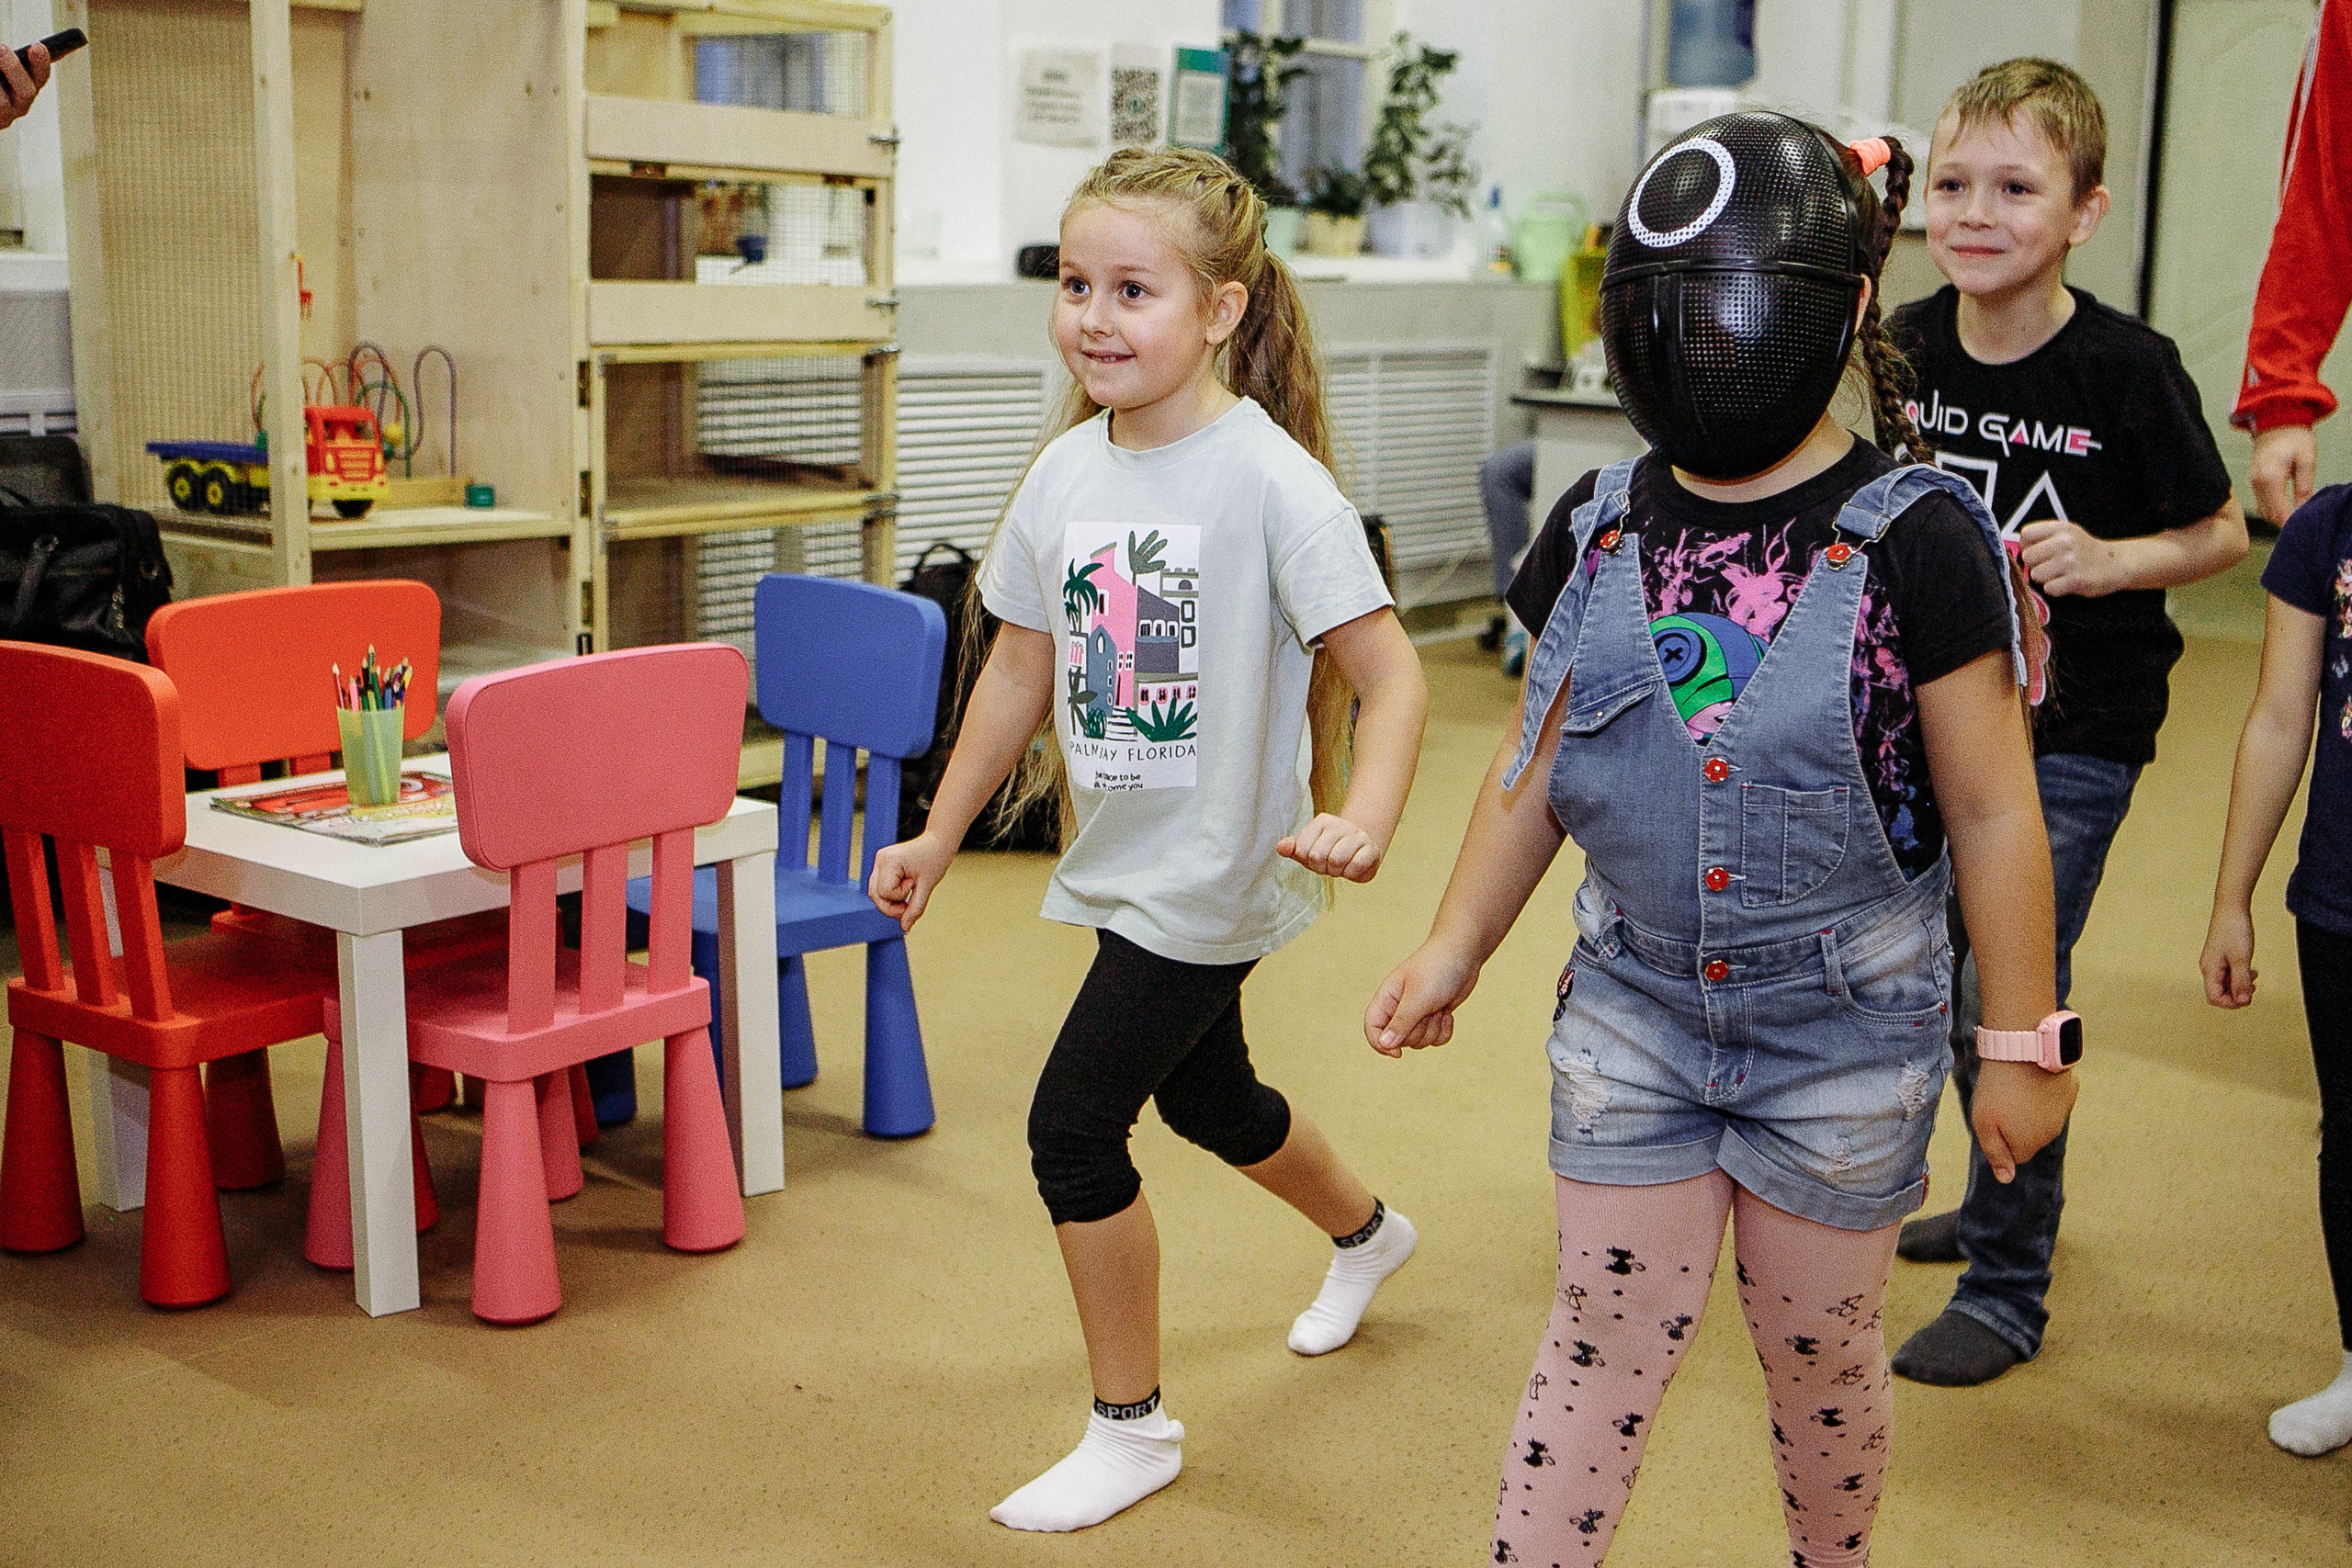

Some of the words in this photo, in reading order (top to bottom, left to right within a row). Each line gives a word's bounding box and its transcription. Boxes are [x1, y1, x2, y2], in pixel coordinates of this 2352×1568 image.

[1895, 389, 1969, 435] QUID
[1979, 412, 2102, 457] GAME
[1128, 744, 1196, 761] FLORIDA
[1130, 773, 1141, 781] be
[1096, 1395, 1157, 1420] SPORT
